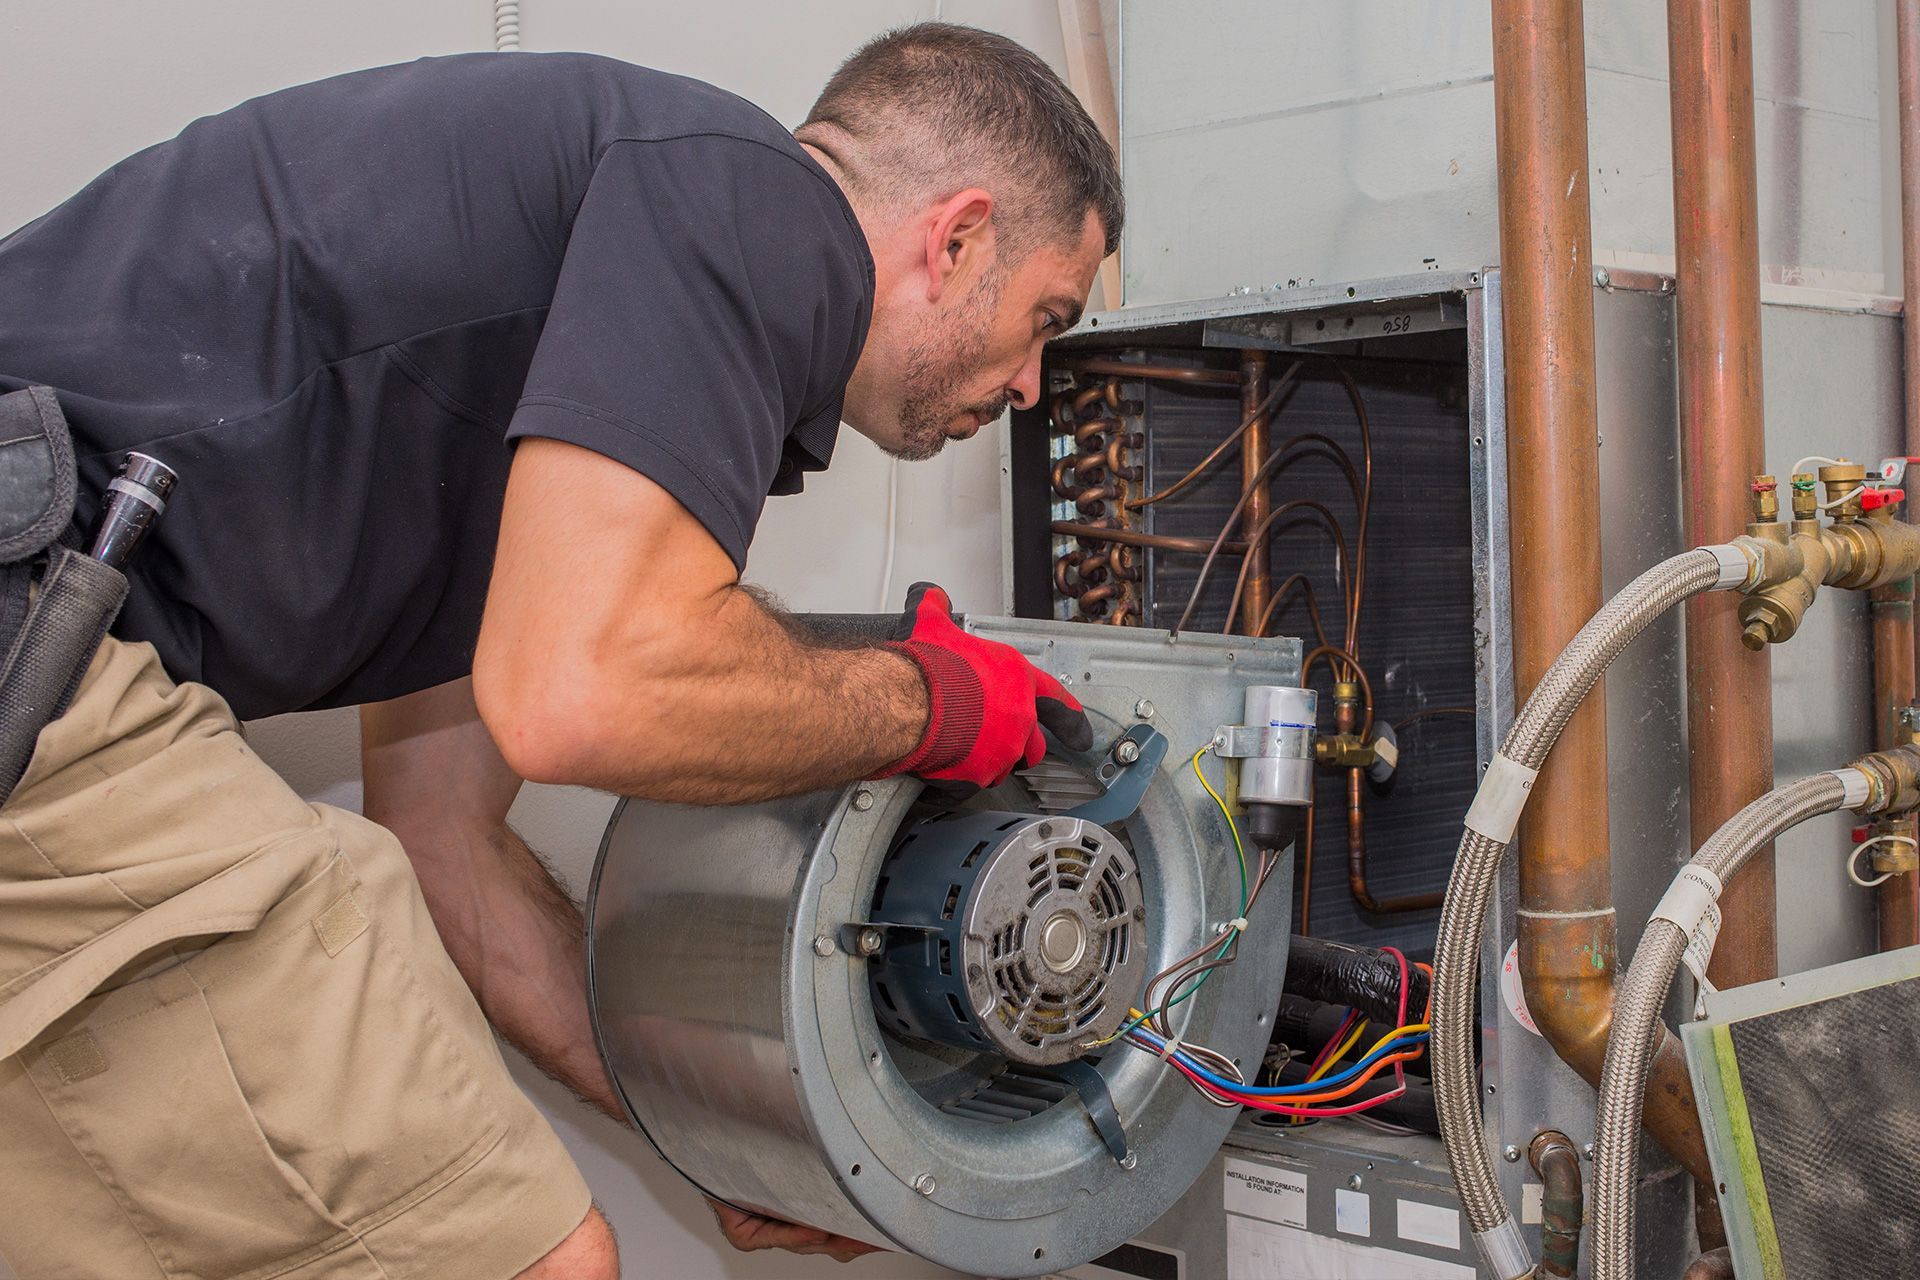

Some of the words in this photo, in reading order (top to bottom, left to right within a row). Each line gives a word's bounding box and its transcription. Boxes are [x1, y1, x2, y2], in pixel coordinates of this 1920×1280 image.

[1383, 315, 1411, 334] 856
[1226, 1170, 1265, 1185] INSTALLATION
[1266, 1180, 1305, 1194] INFORMATION
[1253, 1184, 1273, 1194] FOUND
